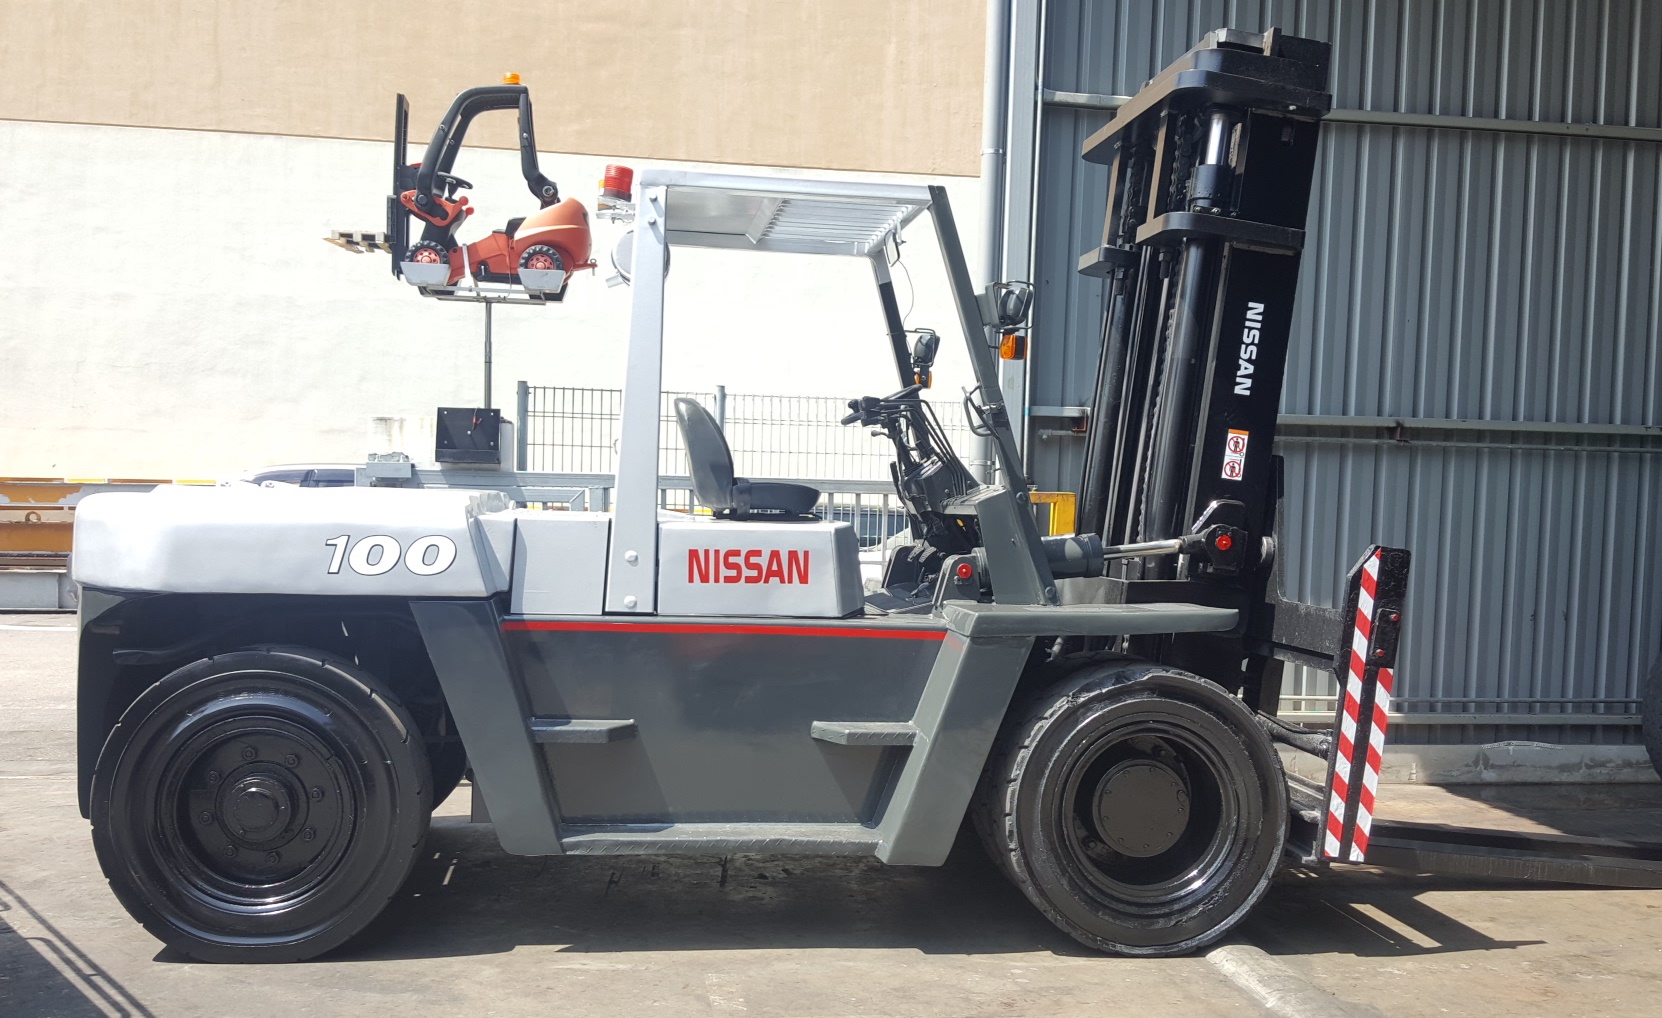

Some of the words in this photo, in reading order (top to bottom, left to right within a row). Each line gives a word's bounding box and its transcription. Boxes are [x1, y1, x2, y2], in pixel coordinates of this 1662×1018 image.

[1234, 301, 1265, 396] NISSAN
[325, 534, 457, 576] 100
[688, 549, 809, 584] NISSAN
